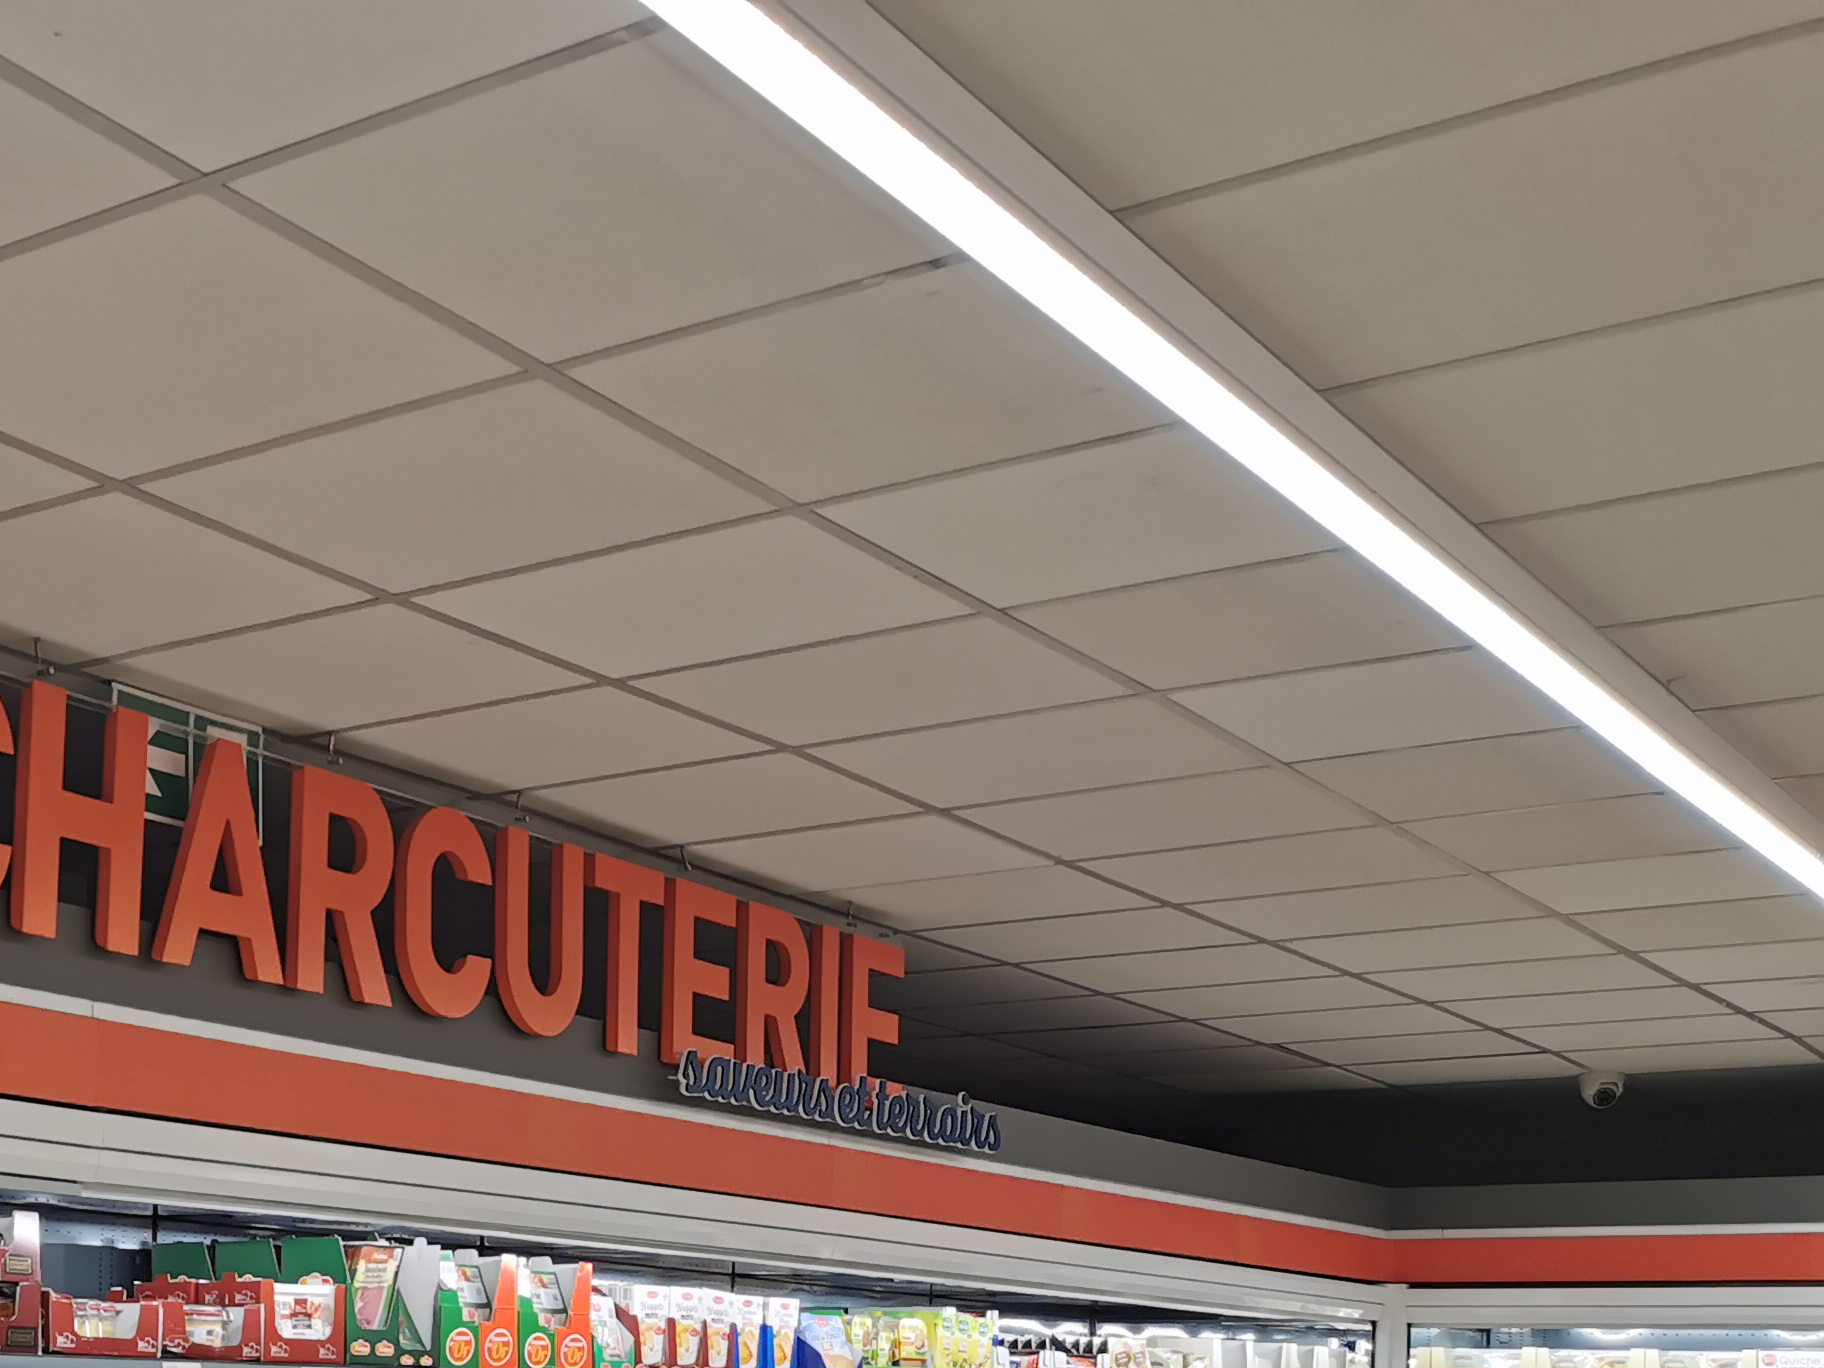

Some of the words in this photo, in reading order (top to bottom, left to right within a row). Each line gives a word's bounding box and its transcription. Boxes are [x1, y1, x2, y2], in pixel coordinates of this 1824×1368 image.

[679, 1048, 833, 1120] saveurs
[835, 1075, 871, 1130] et
[873, 1078, 1000, 1153] terroirs
[1779, 1356, 1821, 1366] Quiche
